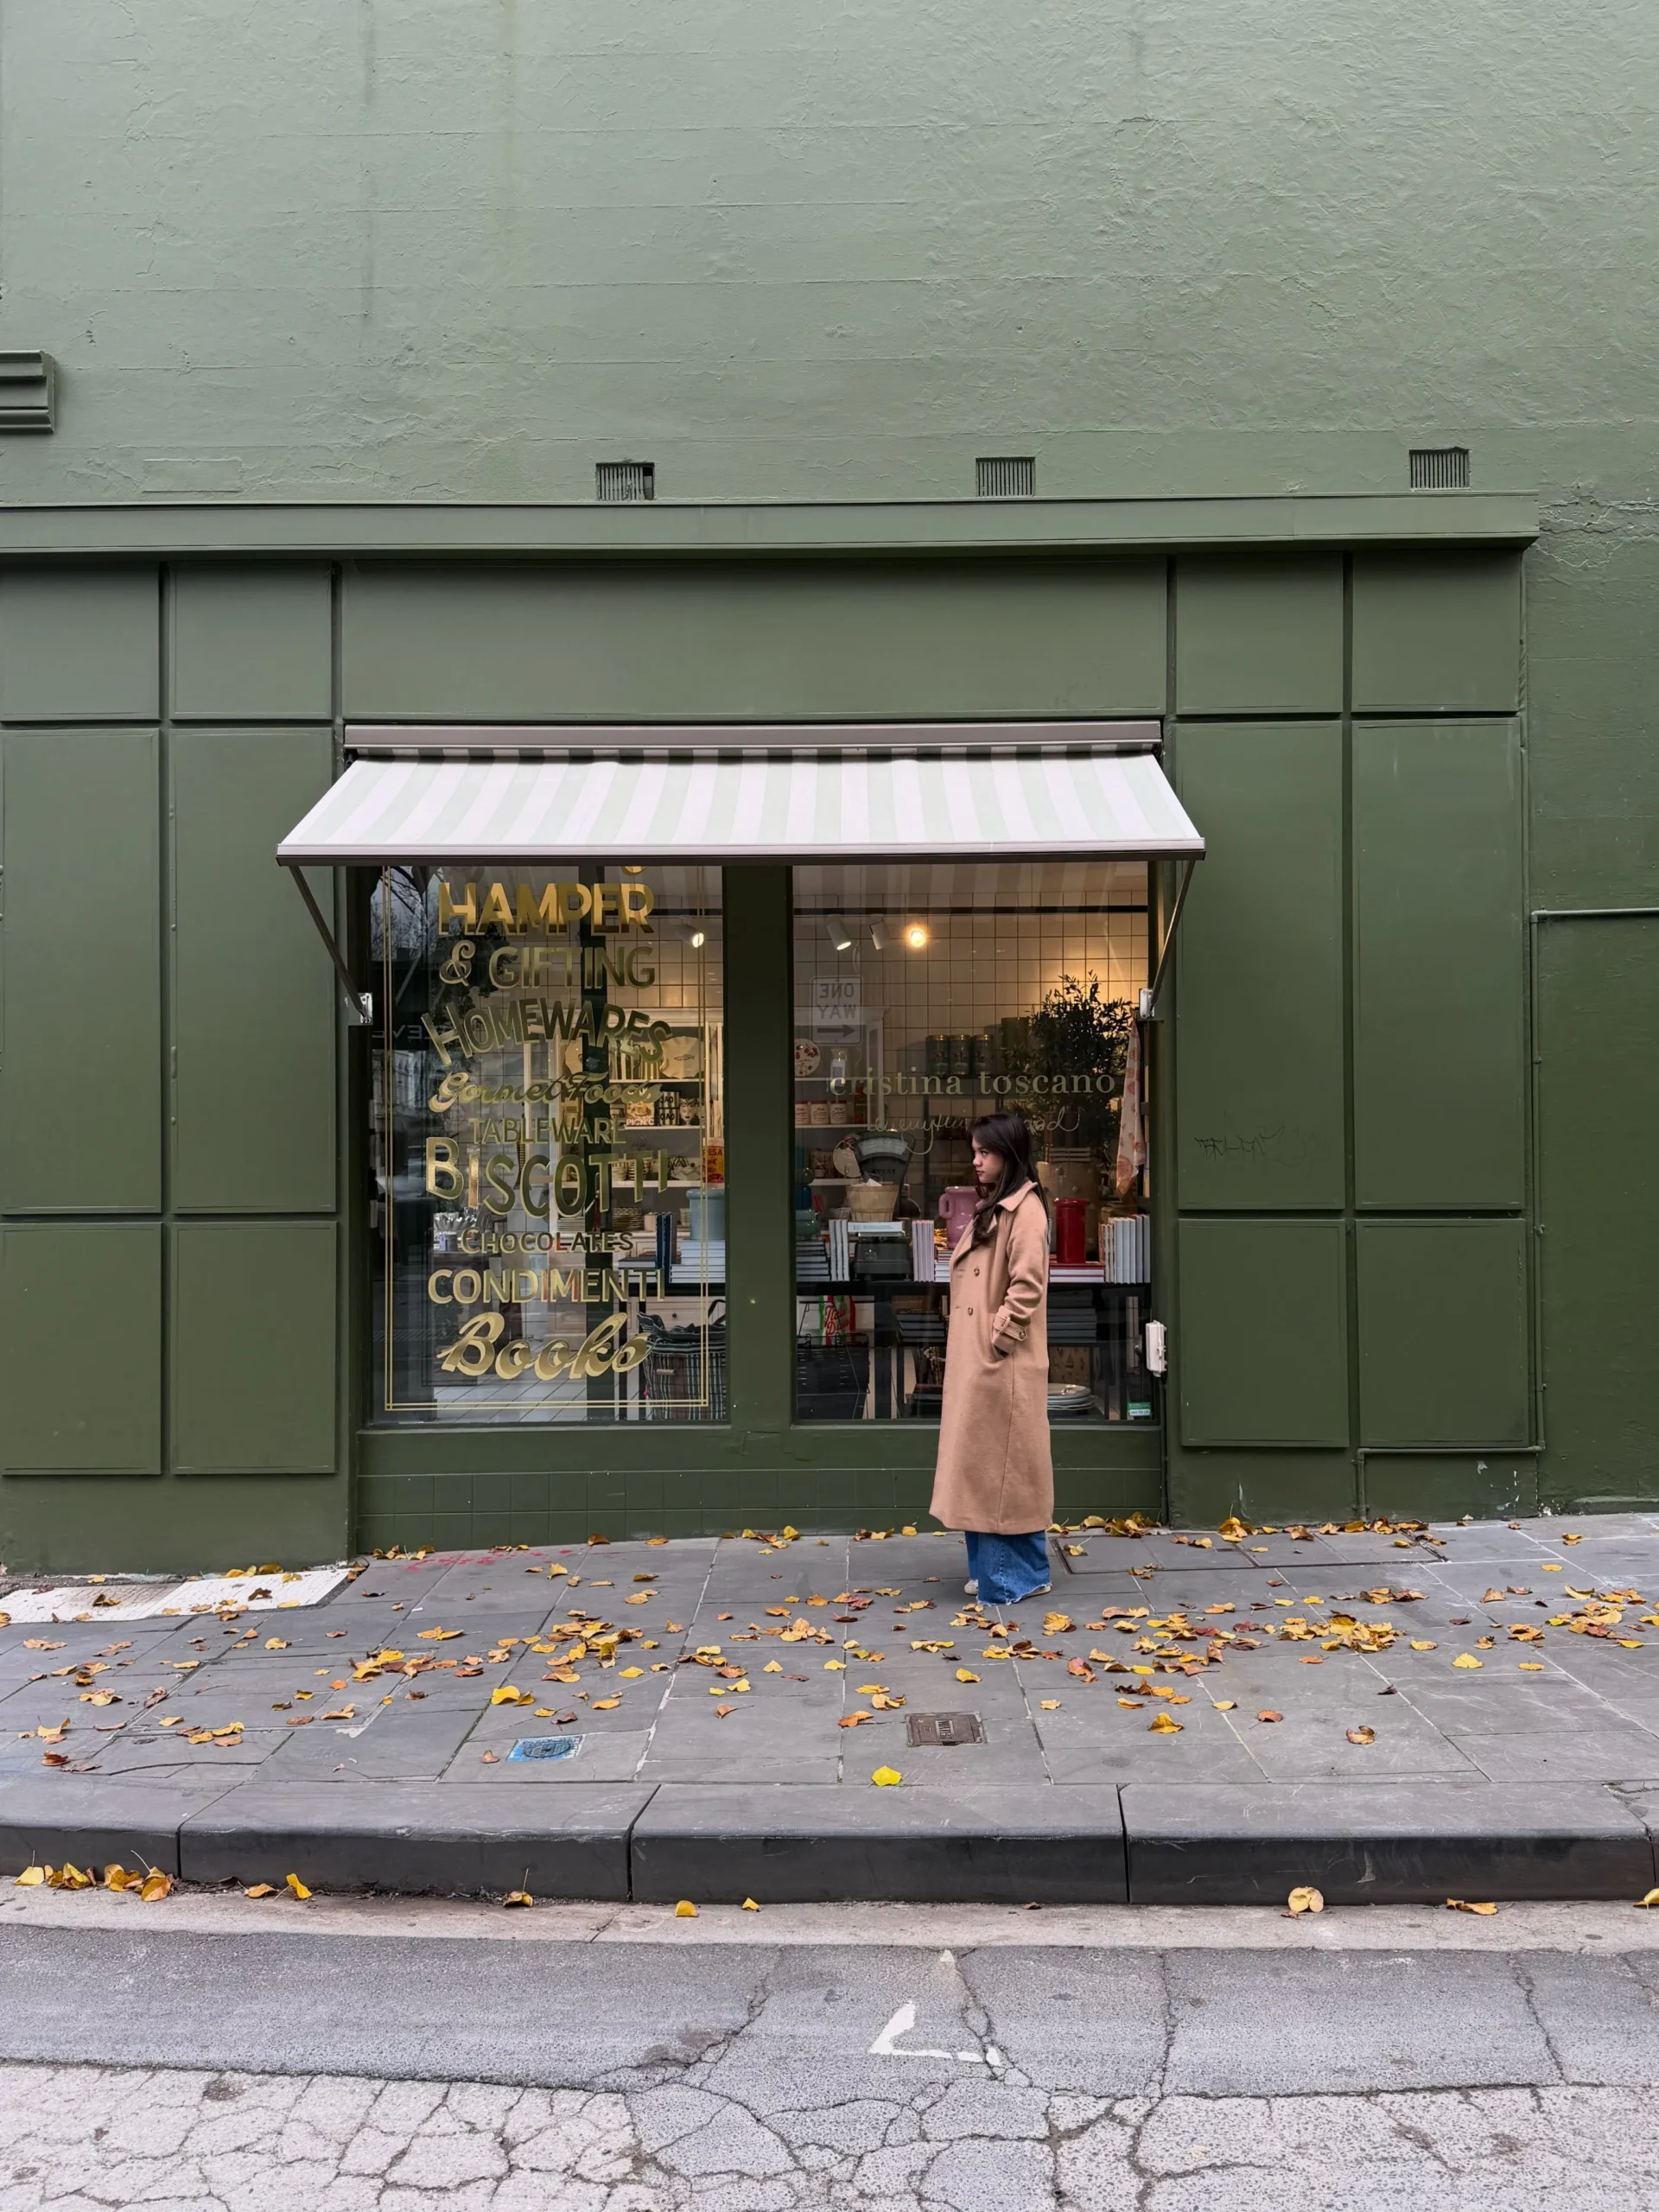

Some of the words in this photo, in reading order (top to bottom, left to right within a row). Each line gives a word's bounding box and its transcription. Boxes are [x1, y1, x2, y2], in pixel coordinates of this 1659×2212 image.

[438, 882, 654, 936] HAMPER
[439, 940, 475, 987] &
[489, 946, 656, 989] GIFTING
[421, 997, 673, 1067] HOMEWARES
[830, 1066, 963, 1096] cristina
[979, 1071, 1116, 1096] toscano
[468, 1117, 627, 1145] TABLEWARE
[426, 1136, 668, 1219] BISCOTTI
[461, 1227, 634, 1254] CHOCOLATES
[428, 1268, 665, 1305] CONDIMENTI
[436, 1311, 659, 1381] Books
